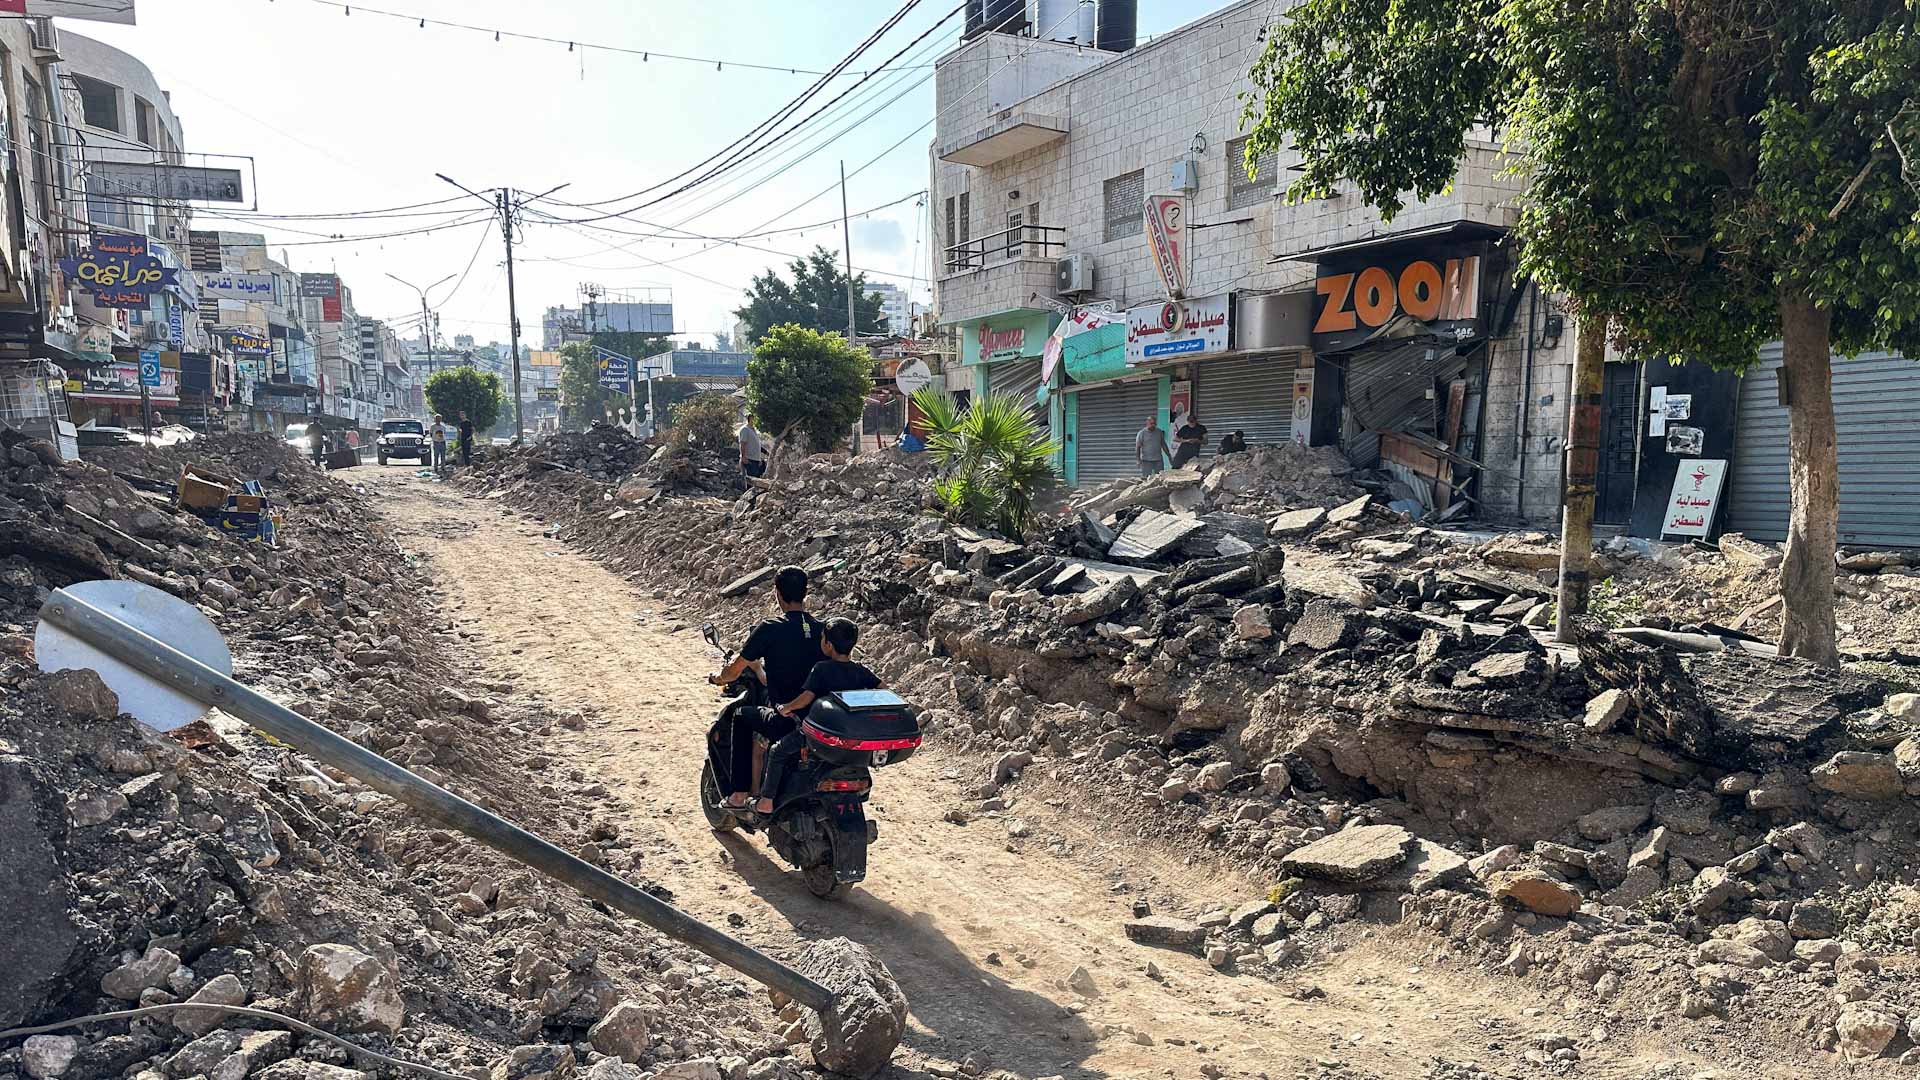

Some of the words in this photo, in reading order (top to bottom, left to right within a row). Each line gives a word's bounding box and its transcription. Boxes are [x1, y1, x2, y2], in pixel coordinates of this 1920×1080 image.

[95, 236, 145, 256] مؤسسة
[1146, 204, 1175, 287] PHARMACY
[78, 254, 163, 286] ضراغمة
[204, 275, 232, 290] تفاحة
[237, 279, 271, 294] بصريات
[1128, 314, 1165, 343] لسطين
[1184, 308, 1225, 336] صيدلية
[1676, 493, 1710, 509] صيدلية
[1670, 514, 1704, 529] فلسطين
